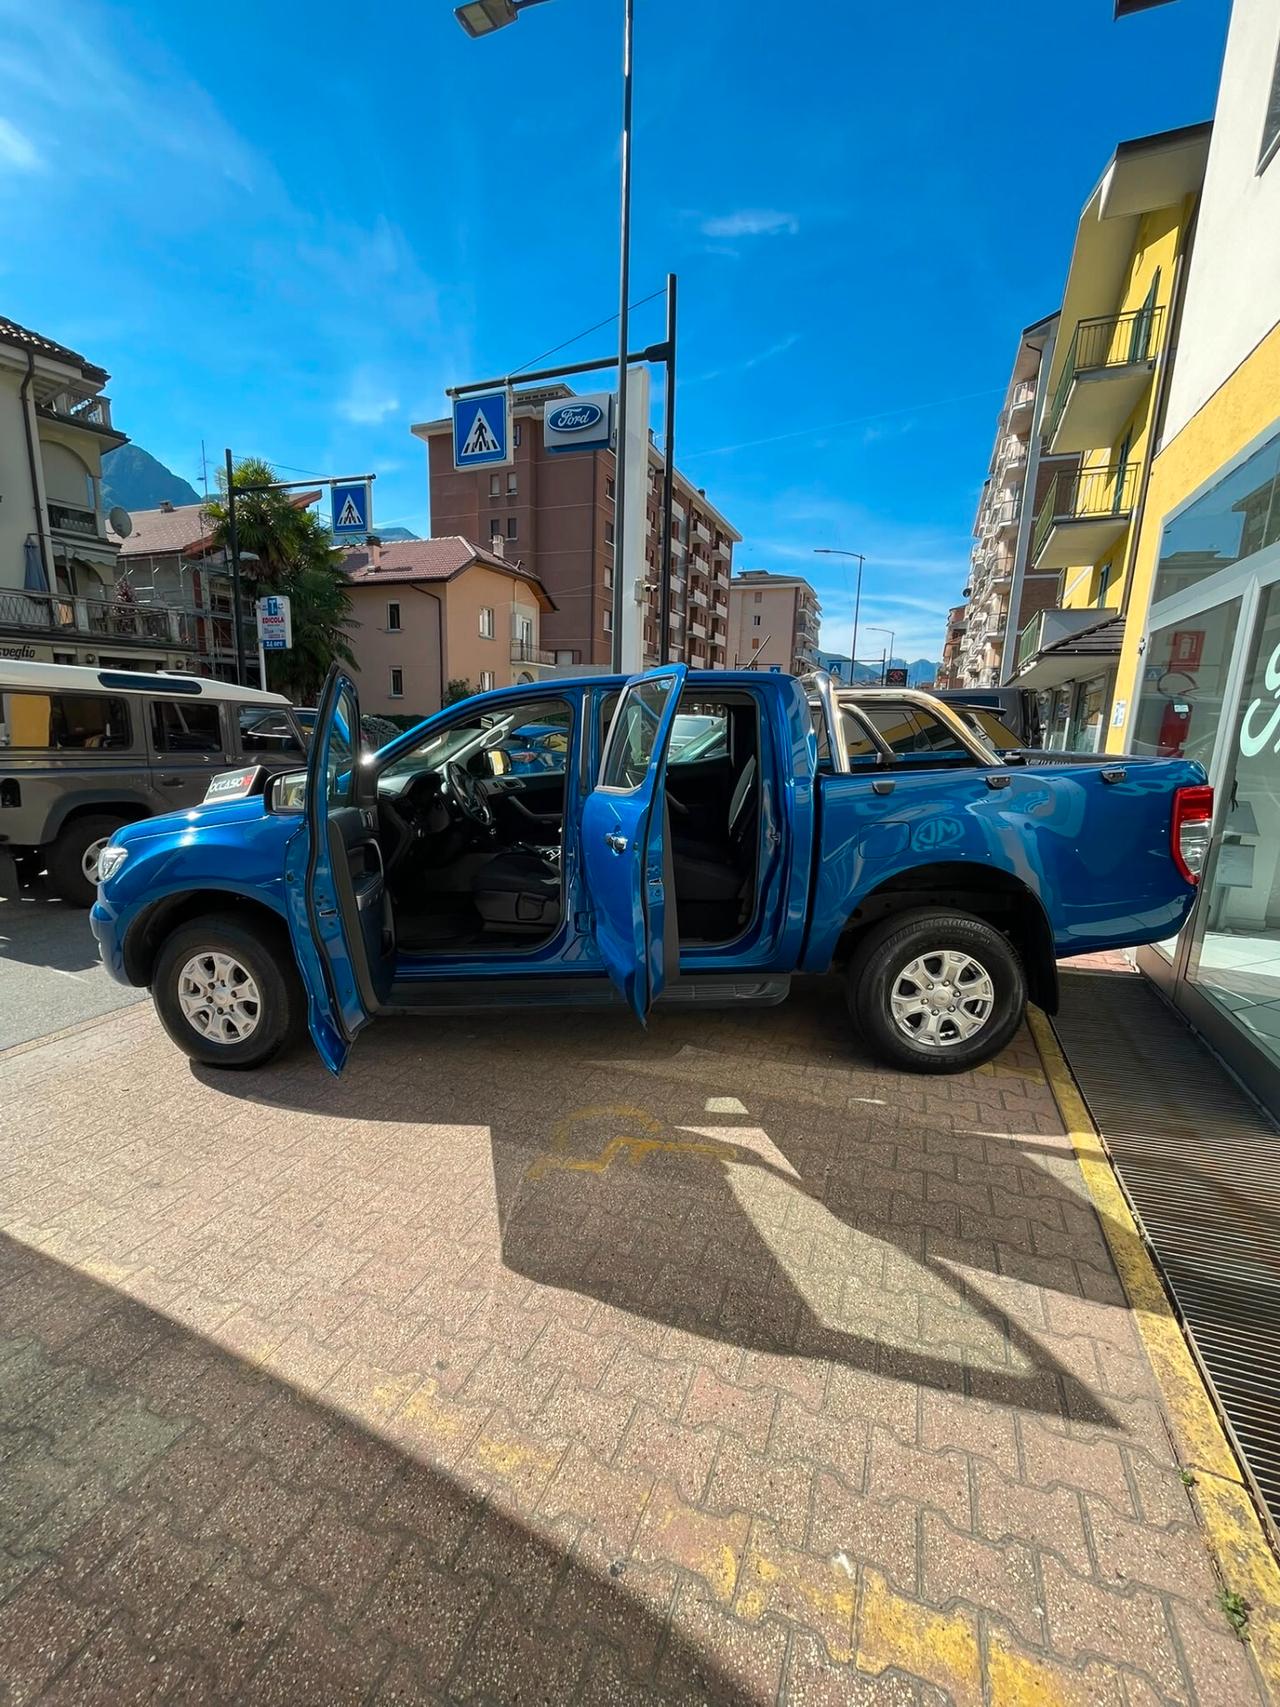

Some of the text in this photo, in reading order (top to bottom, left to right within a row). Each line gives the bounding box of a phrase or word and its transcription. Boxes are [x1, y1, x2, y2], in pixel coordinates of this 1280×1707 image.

[557, 407, 591, 427] Ford
[262, 616, 285, 624] EDICOLA
[0, 645, 36, 660] veglio
